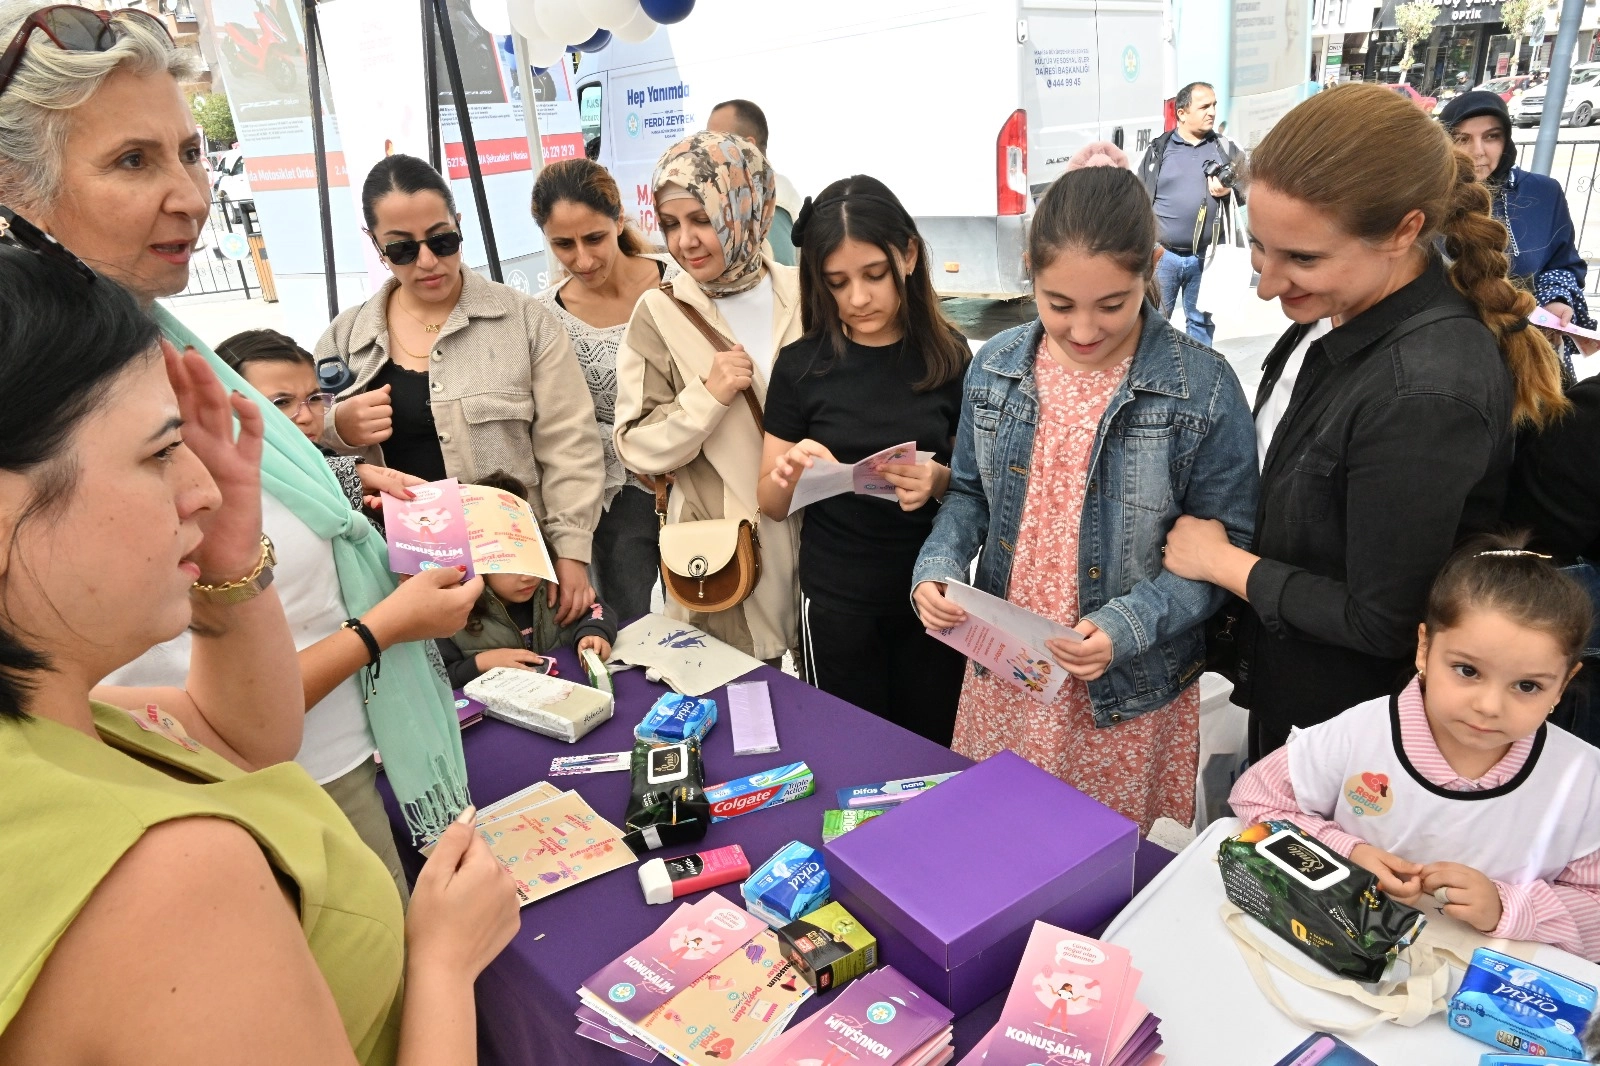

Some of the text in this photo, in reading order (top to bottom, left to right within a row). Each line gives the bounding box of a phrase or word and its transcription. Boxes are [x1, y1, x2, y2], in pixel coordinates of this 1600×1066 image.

[1451, 8, 1482, 20] OPTİK
[1052, 77, 1081, 87] 444 99 45
[627, 81, 690, 108] Hep Yanımda
[644, 114, 695, 128] FERDİ ZEYREK
[1136, 129, 1151, 152] FIAT
[259, 167, 297, 182] Motosiklet
[296, 166, 314, 178] Ordu
[674, 701, 695, 722] Orkid
[784, 786, 808, 796] Action
[788, 779, 809, 790] Triple
[903, 781, 924, 789] nano
[1355, 786, 1379, 803] Regl
[714, 791, 771, 813] Colgate
[1348, 789, 1383, 812] Tabusu
[788, 862, 820, 891] Orkid
[622, 955, 676, 994] KONUŞALIM
[732, 986, 763, 1023] Doğal olan
[1492, 983, 1558, 1012] Orkid
[689, 1024, 716, 1050] Tabusu
[699, 1031, 720, 1049] Regl
[824, 1016, 892, 1059] KONUŞALIM
[1005, 1026, 1092, 1063] KONUŞALIM
